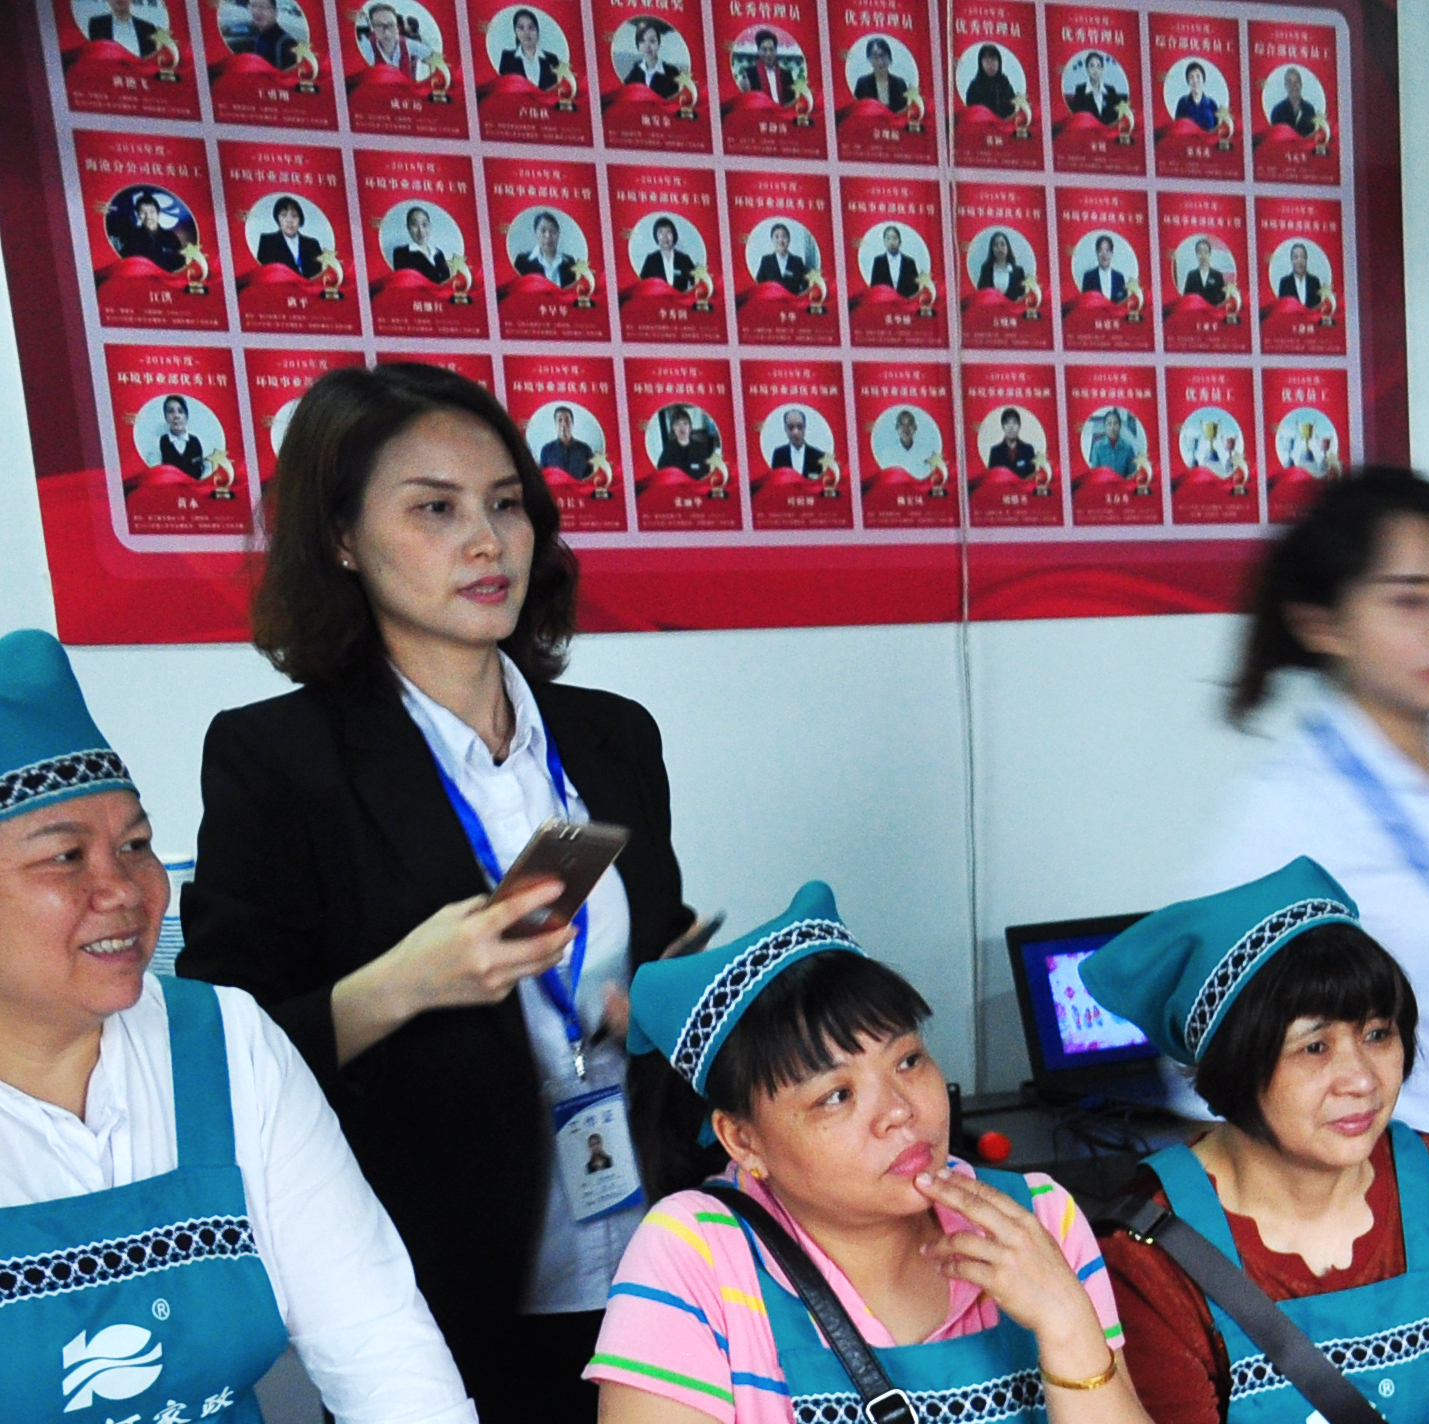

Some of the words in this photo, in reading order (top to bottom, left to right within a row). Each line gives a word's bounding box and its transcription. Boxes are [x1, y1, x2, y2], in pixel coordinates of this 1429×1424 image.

[730, 1, 801, 22] 优秀管理员
[844, 9, 913, 31] 优秀管理员
[956, 18, 1021, 38] 优秀管理员
[1061, 27, 1125, 46] 优秀管理员
